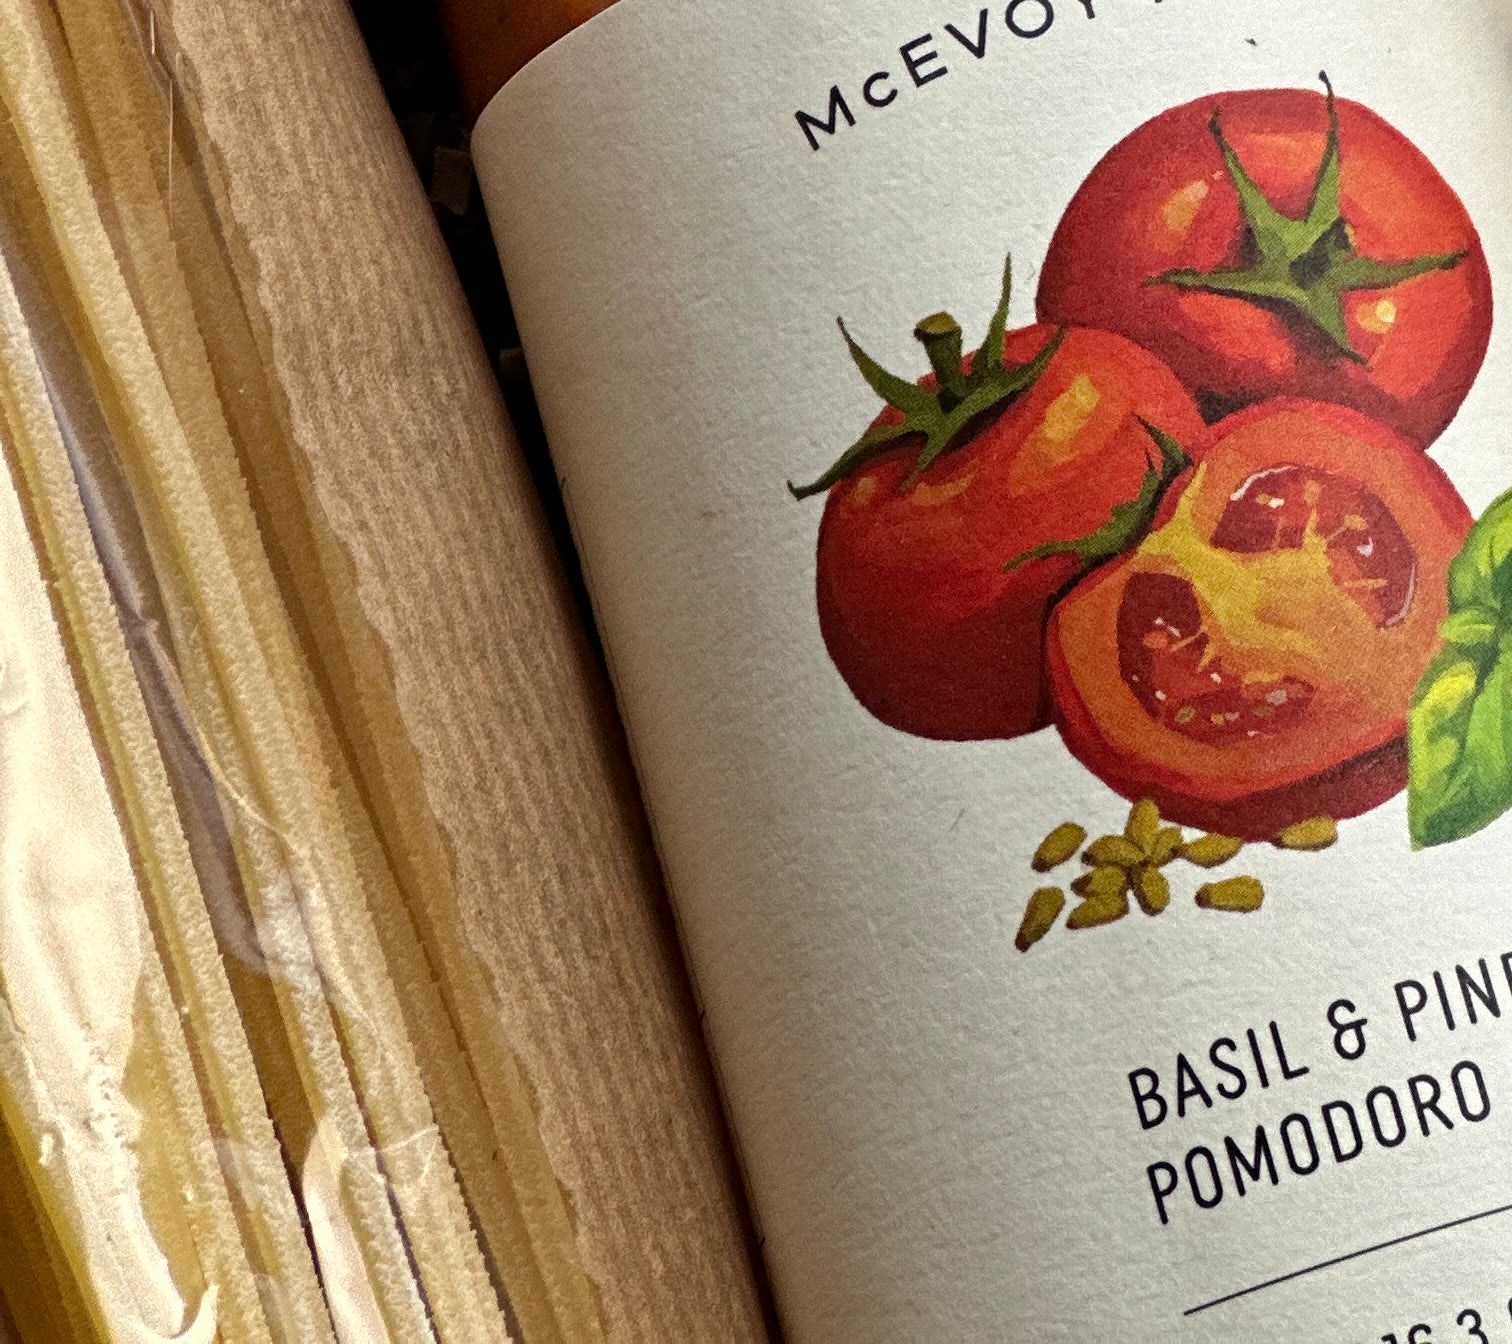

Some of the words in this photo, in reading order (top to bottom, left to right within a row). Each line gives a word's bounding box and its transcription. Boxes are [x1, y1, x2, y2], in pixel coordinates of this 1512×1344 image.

[1127, 1020, 1310, 1130] BASIL
[1326, 999, 1369, 1060] &
[1145, 1060, 1492, 1226] POMODORO
